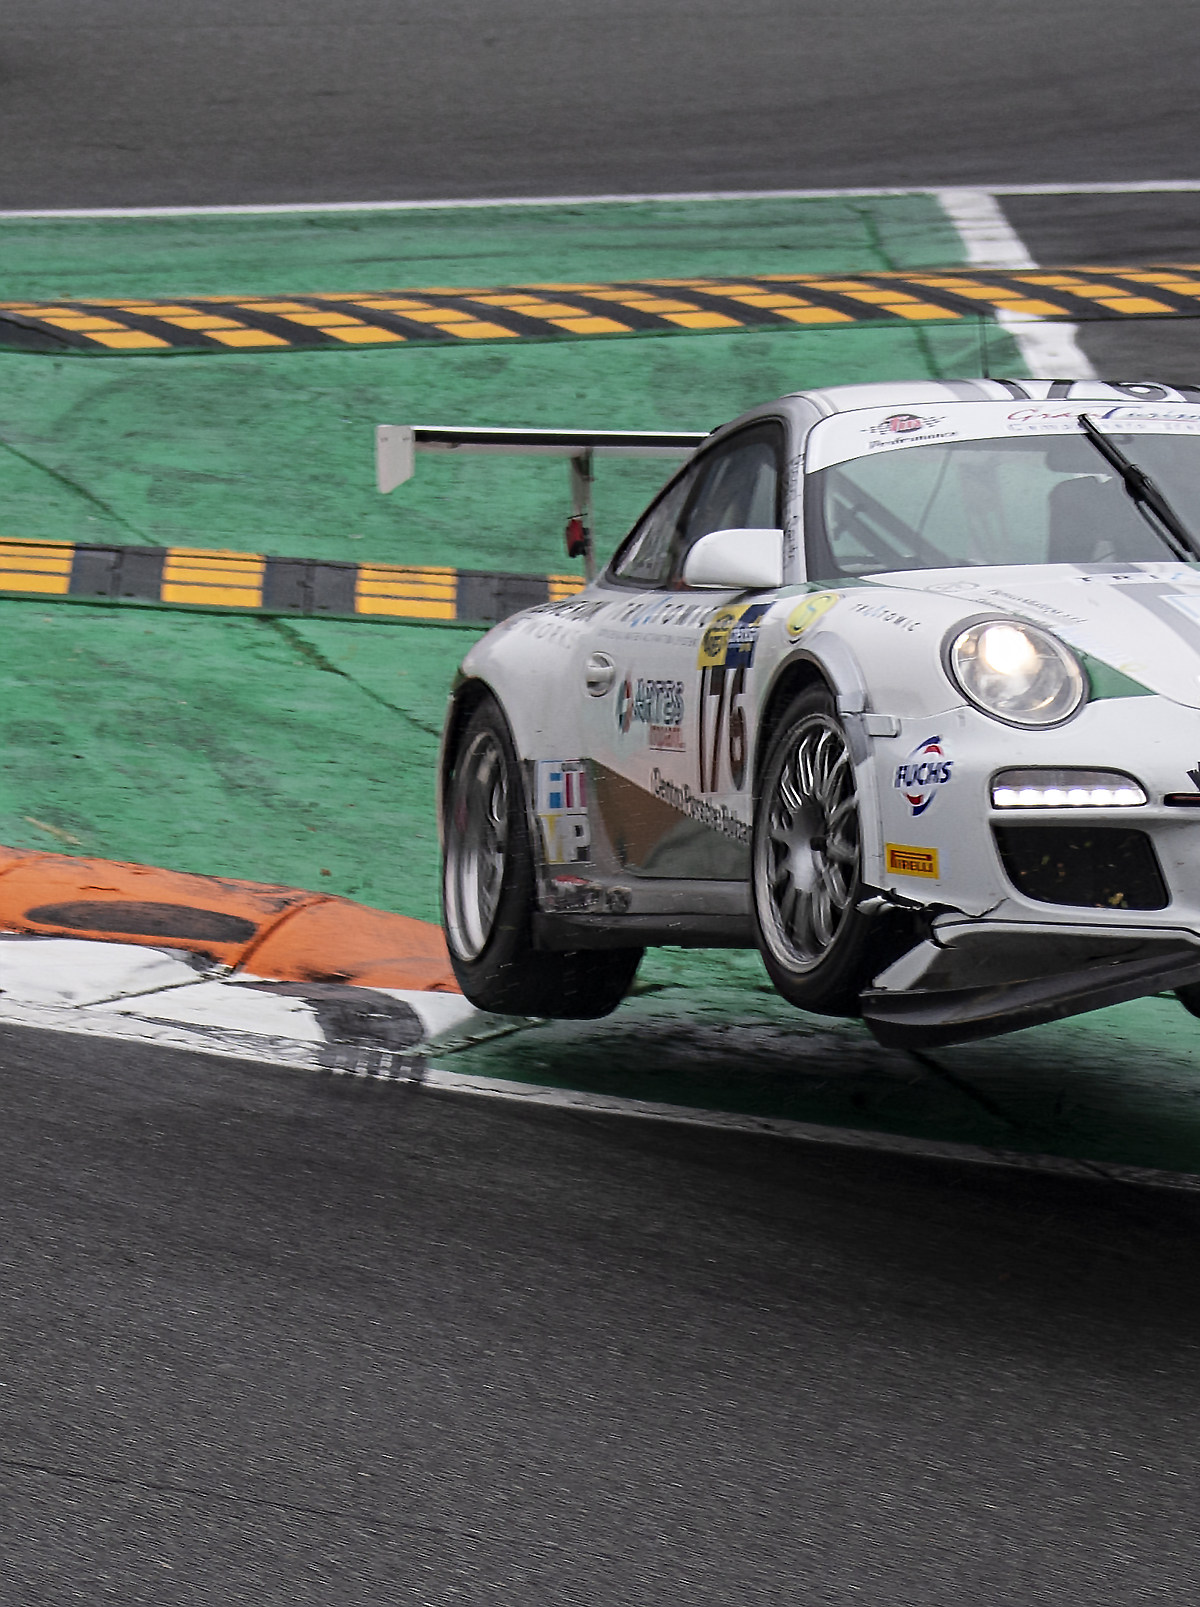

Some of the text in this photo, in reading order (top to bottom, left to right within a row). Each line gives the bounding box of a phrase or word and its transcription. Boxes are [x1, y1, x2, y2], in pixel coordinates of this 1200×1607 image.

[698, 664, 748, 793] 176
[893, 760, 954, 788] FUCHS
[891, 849, 934, 873] PIRELLI
